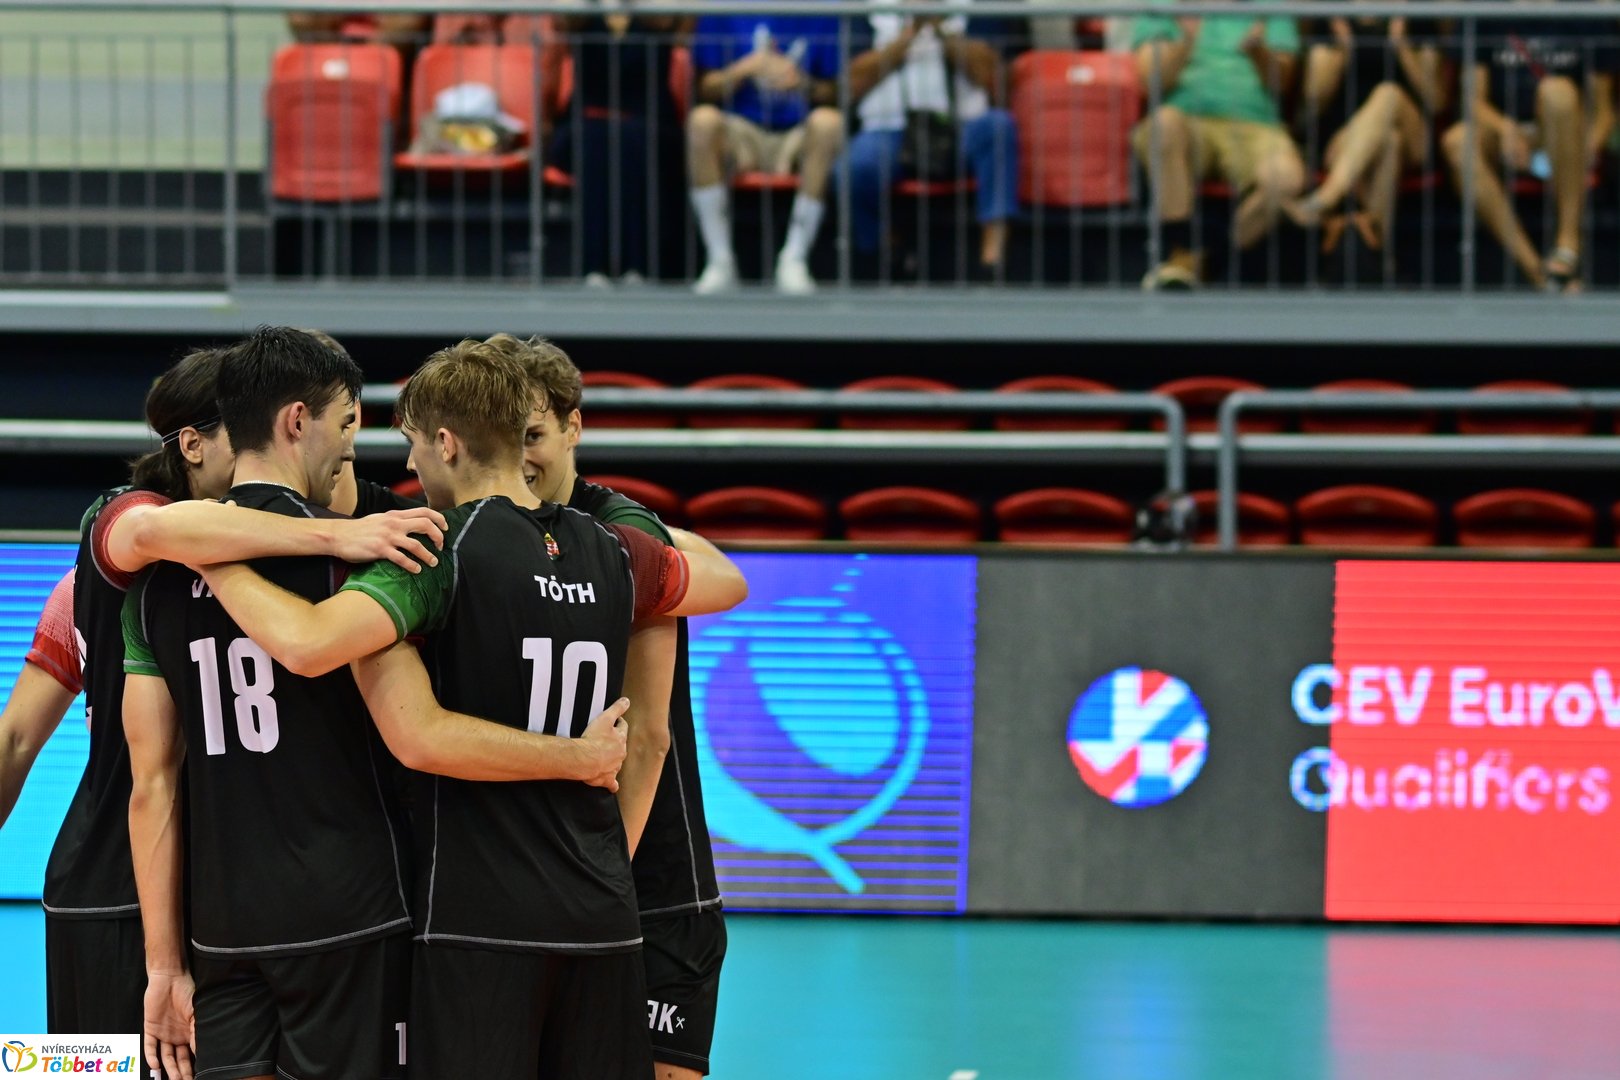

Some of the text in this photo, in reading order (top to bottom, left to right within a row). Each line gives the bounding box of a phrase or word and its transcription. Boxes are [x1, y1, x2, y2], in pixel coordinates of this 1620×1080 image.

[189, 636, 279, 755] 18
[522, 637, 608, 738] 10
[1291, 663, 1434, 726] CEV
[1289, 746, 1612, 815] Qualifiers
